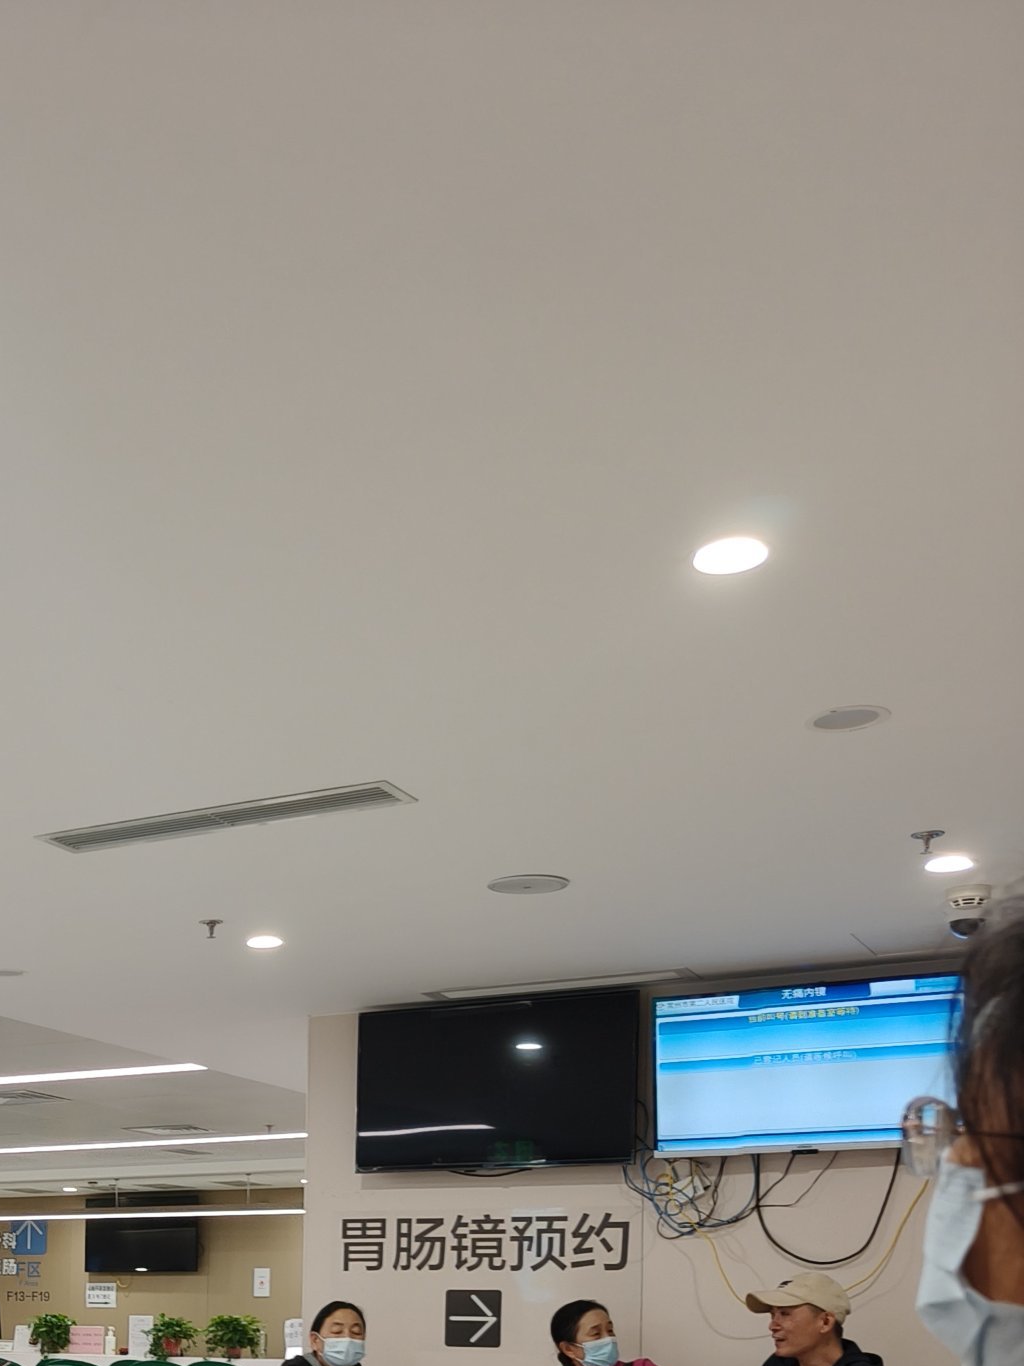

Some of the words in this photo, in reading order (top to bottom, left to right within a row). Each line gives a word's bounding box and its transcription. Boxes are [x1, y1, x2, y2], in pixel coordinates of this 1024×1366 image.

[781, 986, 827, 1000] 无痛内镜
[341, 1212, 631, 1272] 胃肠镜预约
[17, 1261, 41, 1278] F区
[6, 1290, 51, 1302] F13-F19
